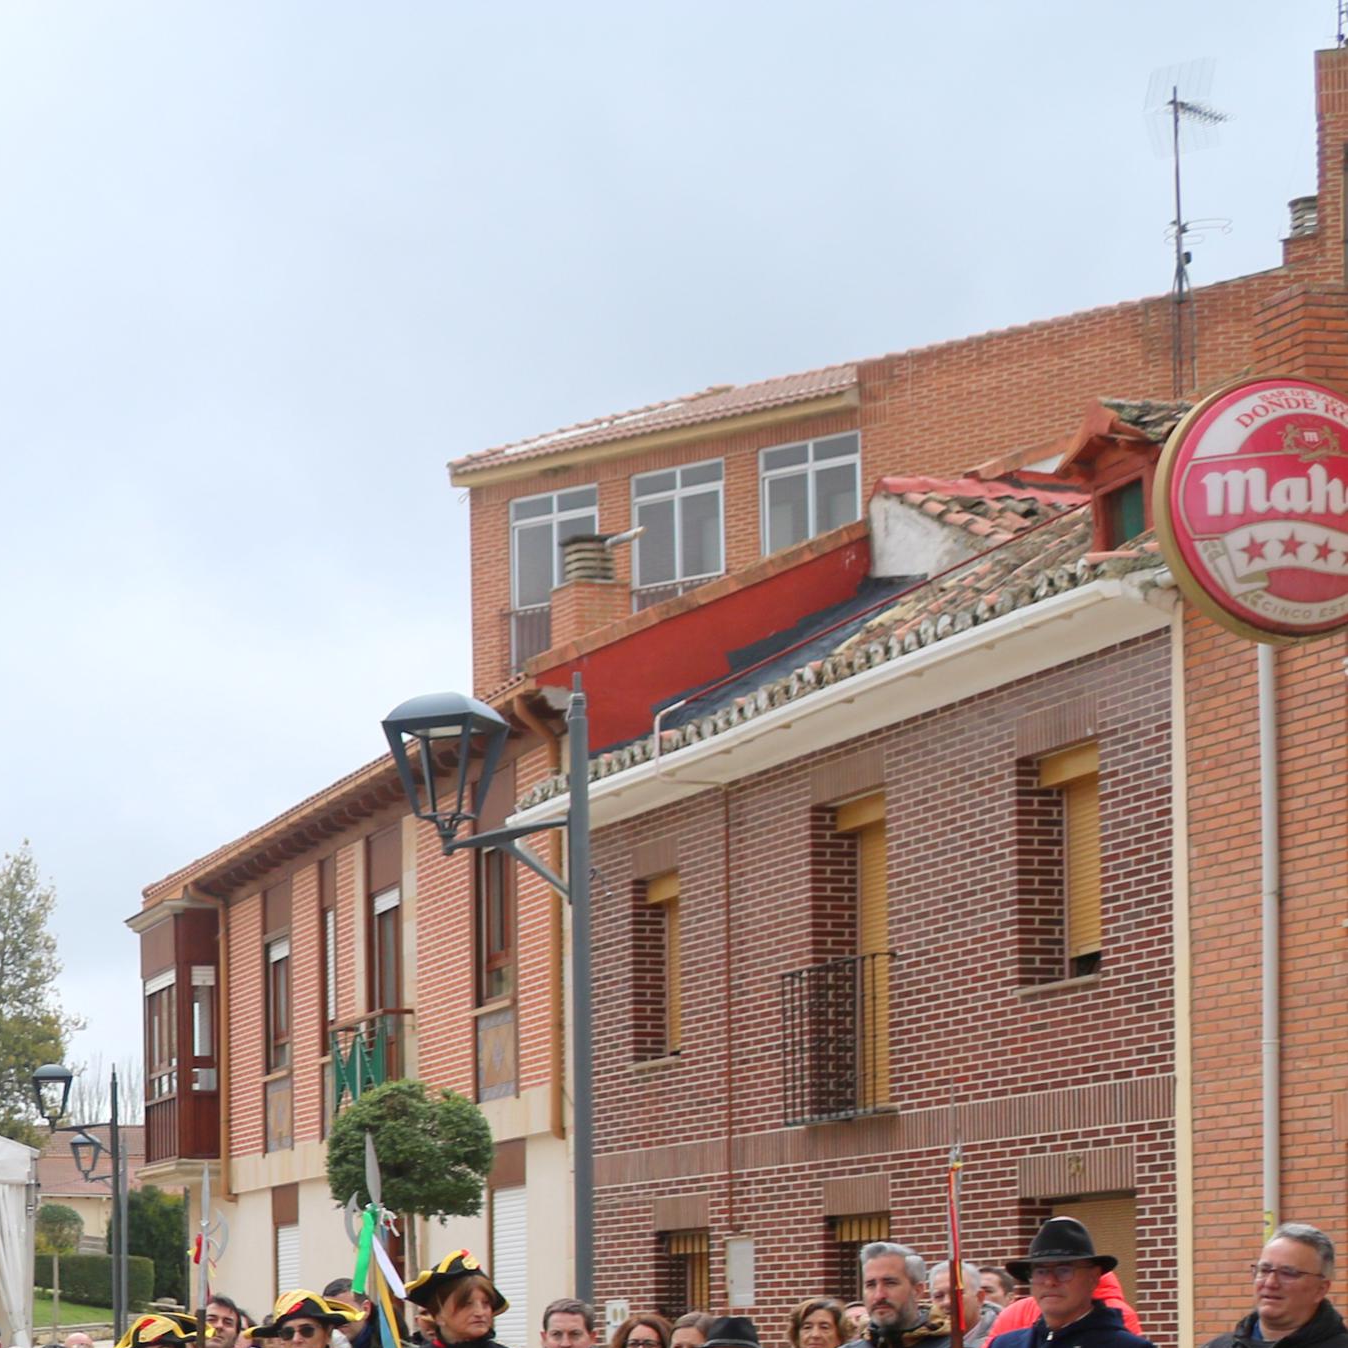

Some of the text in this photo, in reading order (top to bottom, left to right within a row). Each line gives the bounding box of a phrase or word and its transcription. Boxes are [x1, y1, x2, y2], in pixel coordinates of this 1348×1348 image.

[1236, 398, 1316, 428] DONDE
[1200, 463, 1348, 516] Mah
[1261, 601, 1312, 619] CINCO
